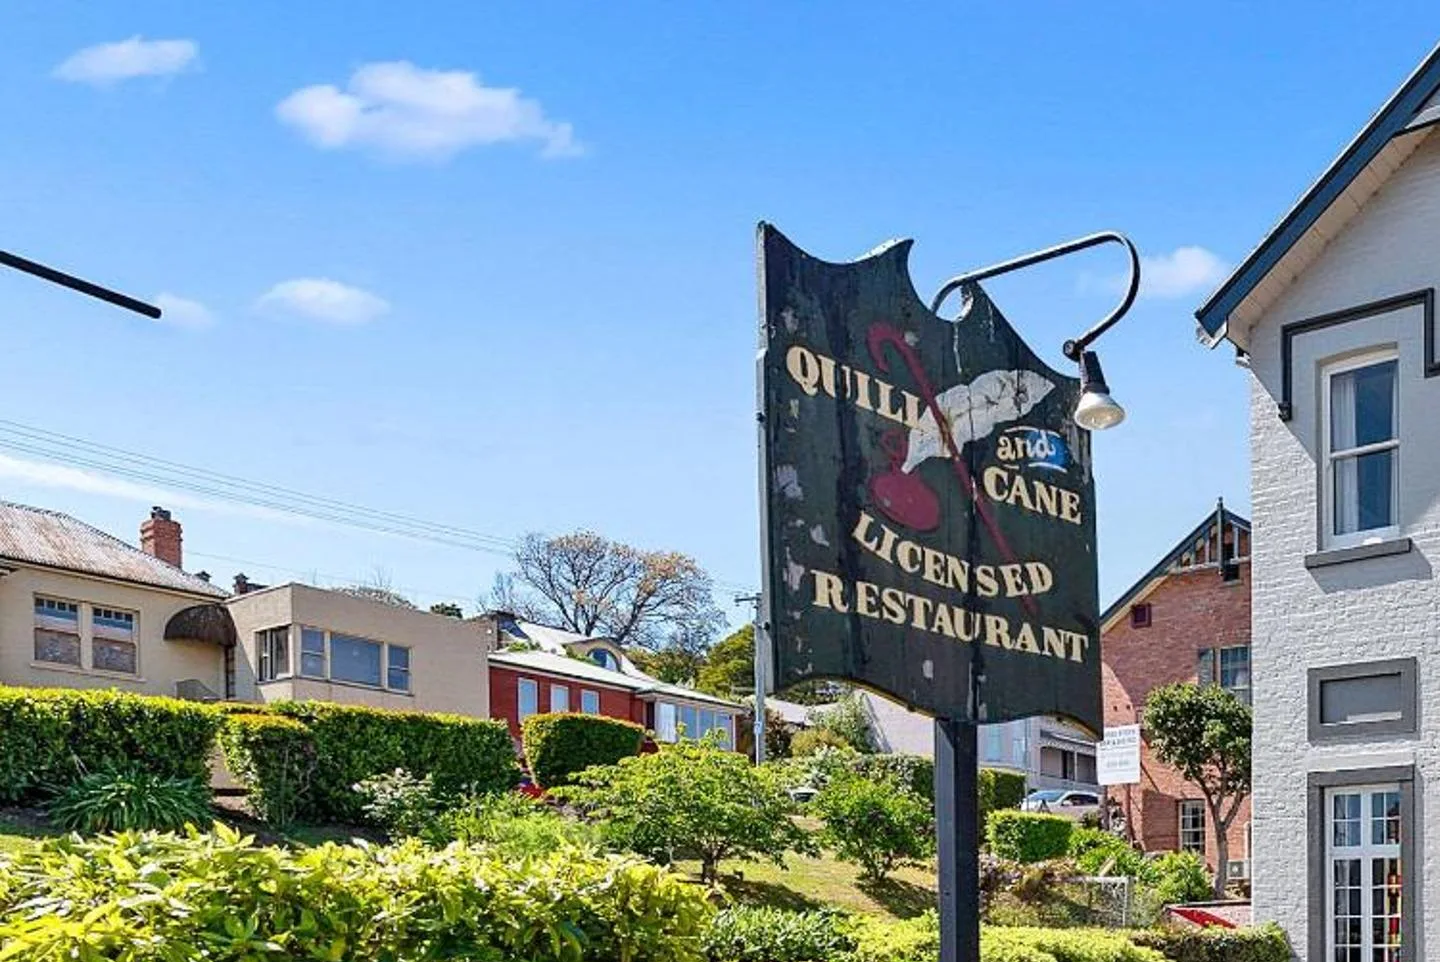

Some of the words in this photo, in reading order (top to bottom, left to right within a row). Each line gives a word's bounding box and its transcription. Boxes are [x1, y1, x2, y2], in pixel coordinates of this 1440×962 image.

[786, 346, 927, 431] QUILL
[997, 430, 1057, 460] and
[983, 466, 1082, 524] CANE
[852, 511, 1054, 598] LICENSED
[811, 569, 1089, 663] RESTAURANT
